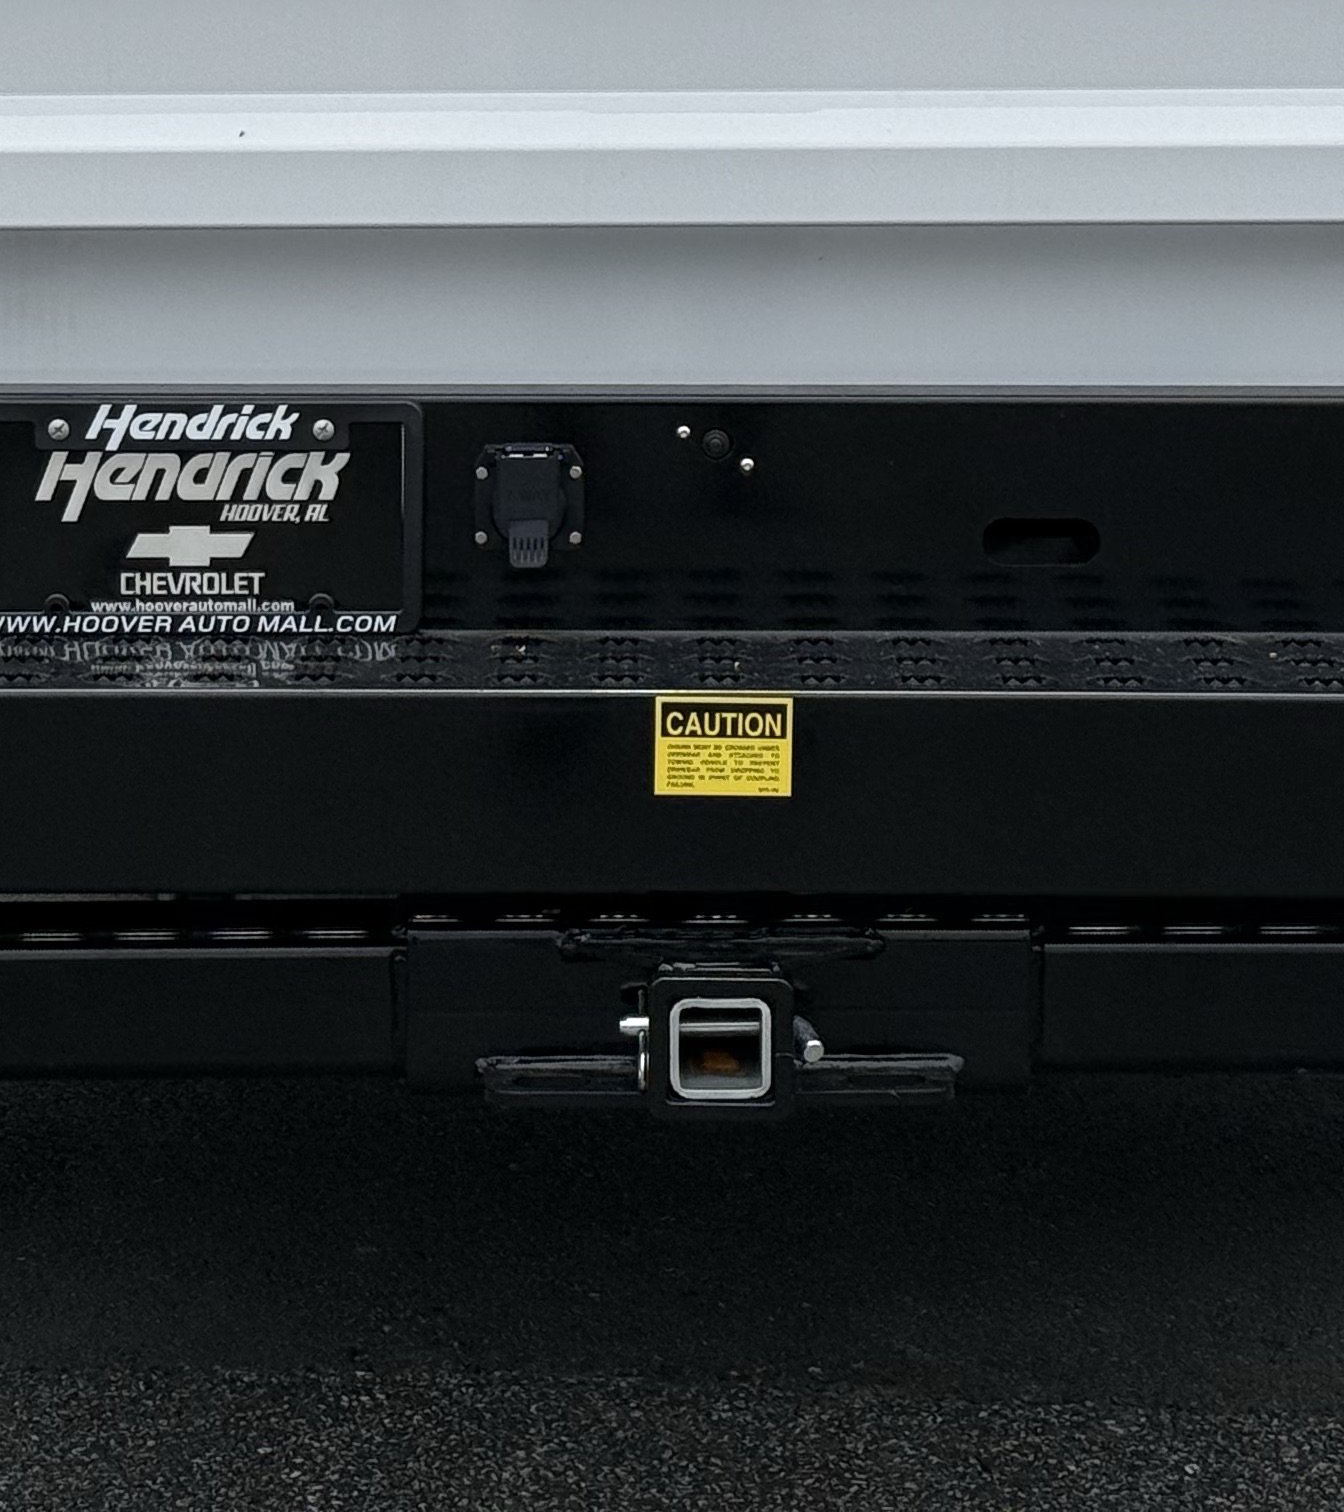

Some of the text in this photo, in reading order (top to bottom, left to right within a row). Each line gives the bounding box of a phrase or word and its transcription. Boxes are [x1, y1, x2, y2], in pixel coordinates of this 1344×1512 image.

[85, 403, 299, 451] Hendrick
[35, 451, 351, 523] Hendrick
[220, 503, 330, 524] HOOVER, AL
[120, 571, 265, 596] CHEVROLET
[91, 598, 295, 613] www.hooverautomall.com
[178, 614, 251, 634] AUTO
[257, 614, 397, 634] MALL.COM
[665, 711, 783, 737] CAUTION
